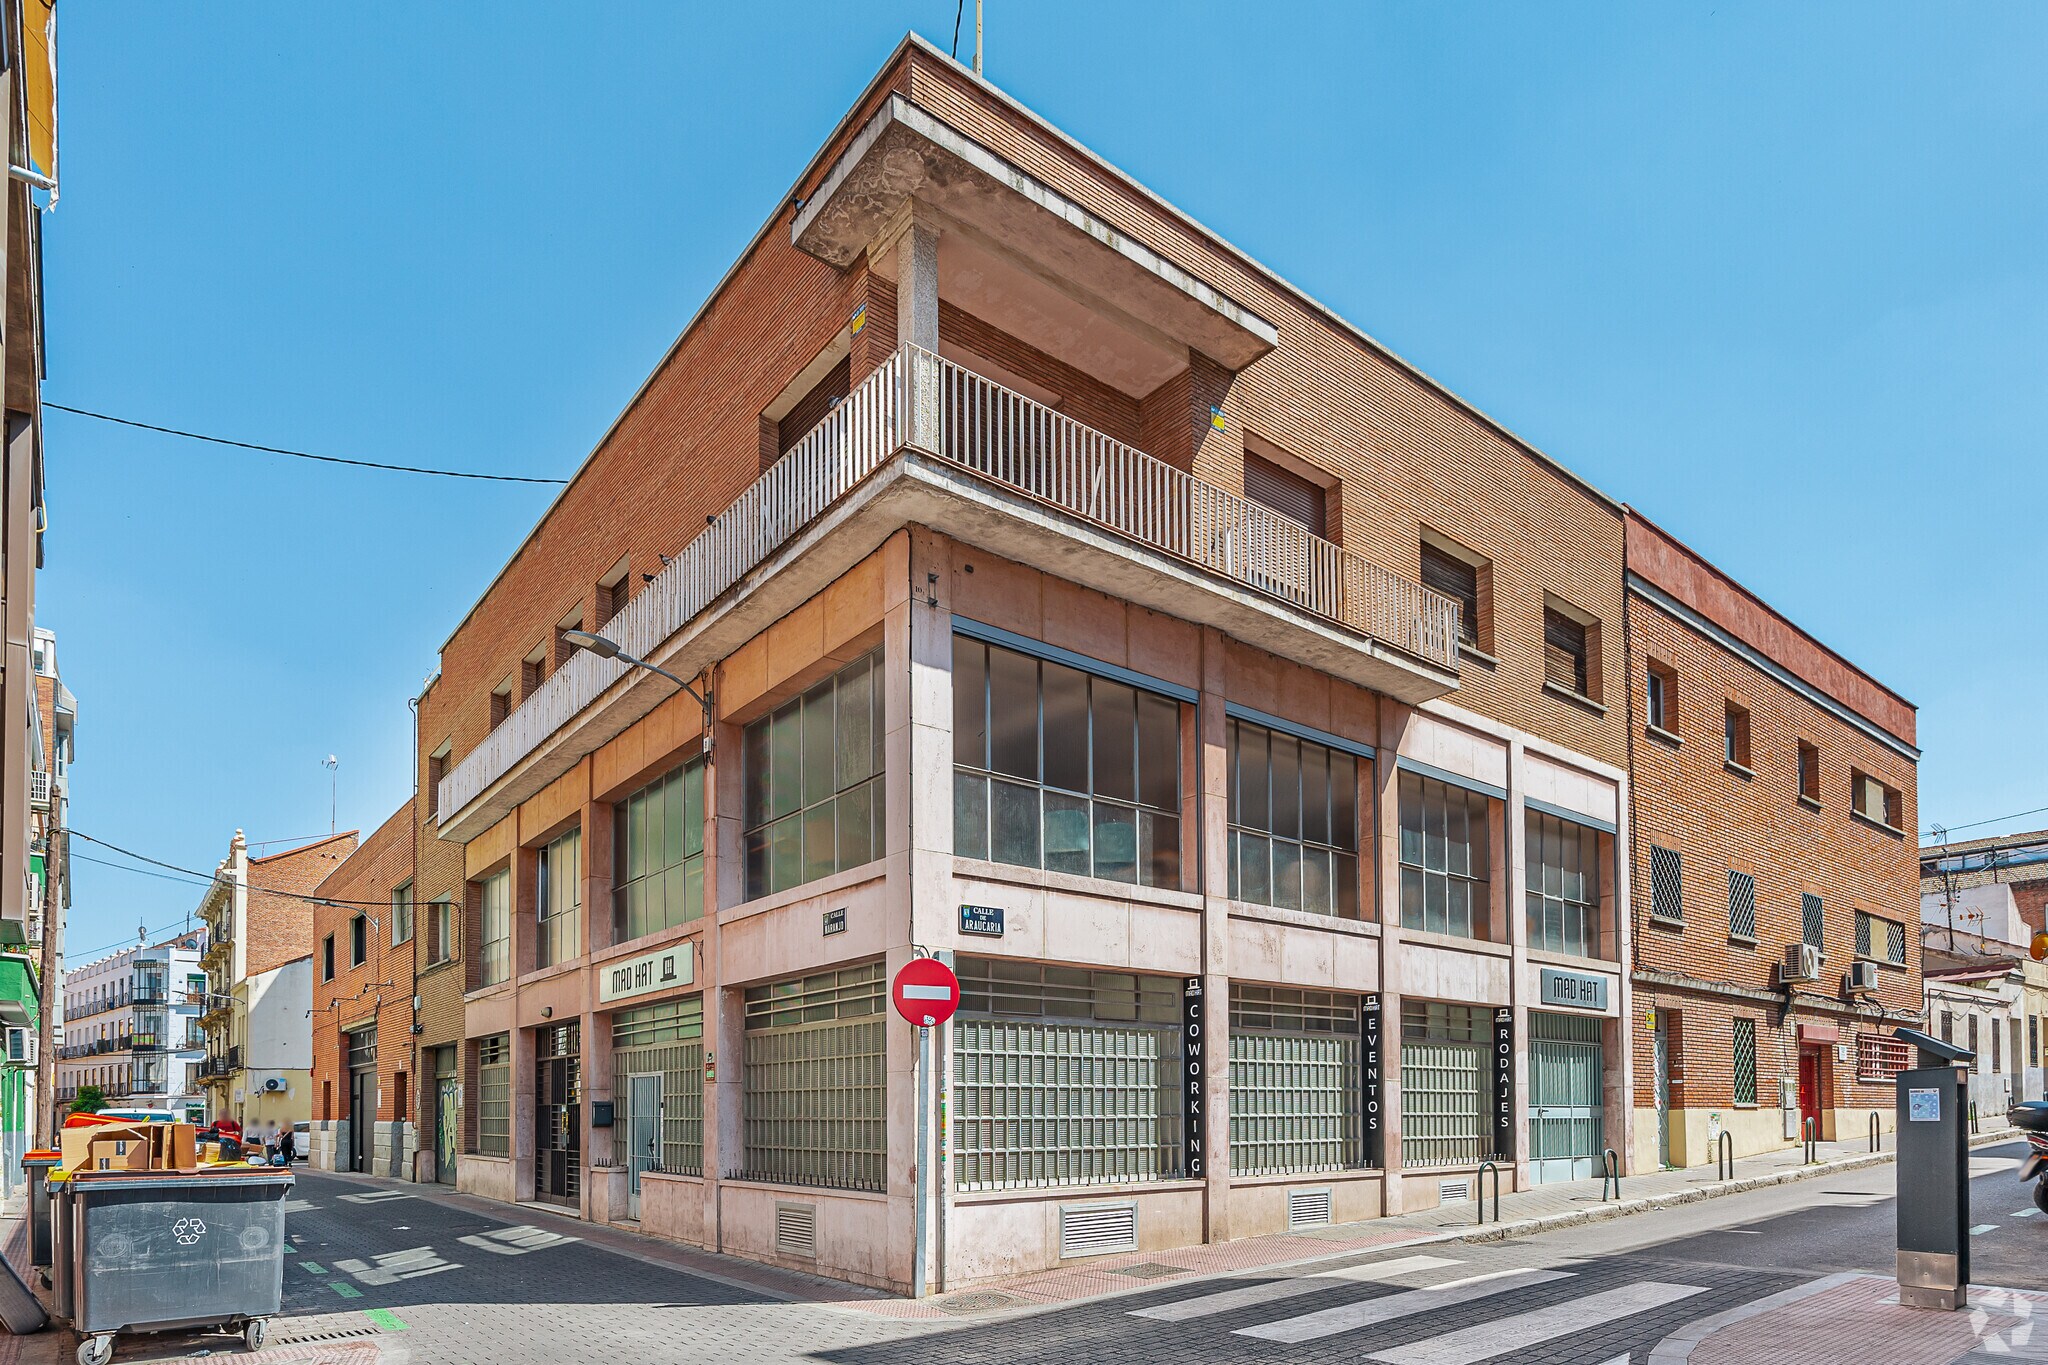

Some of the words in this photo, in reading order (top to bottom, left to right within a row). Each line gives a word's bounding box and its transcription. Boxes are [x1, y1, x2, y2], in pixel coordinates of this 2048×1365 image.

[830, 910, 844, 919] CALLE
[973, 907, 994, 916] CALLE
[824, 920, 844, 935] NARANJO
[965, 919, 1002, 933] ARAUCARIA
[612, 967, 632, 994] MAD
[635, 960, 653, 988] HAT
[1553, 976, 1576, 1000] MAD
[1580, 979, 1598, 1002] HAT
[1367, 1018, 1378, 1130] EVENTOS
[1499, 1028, 1509, 1128] RODAJES
[1188, 1004, 1200, 1172] COWORKING
